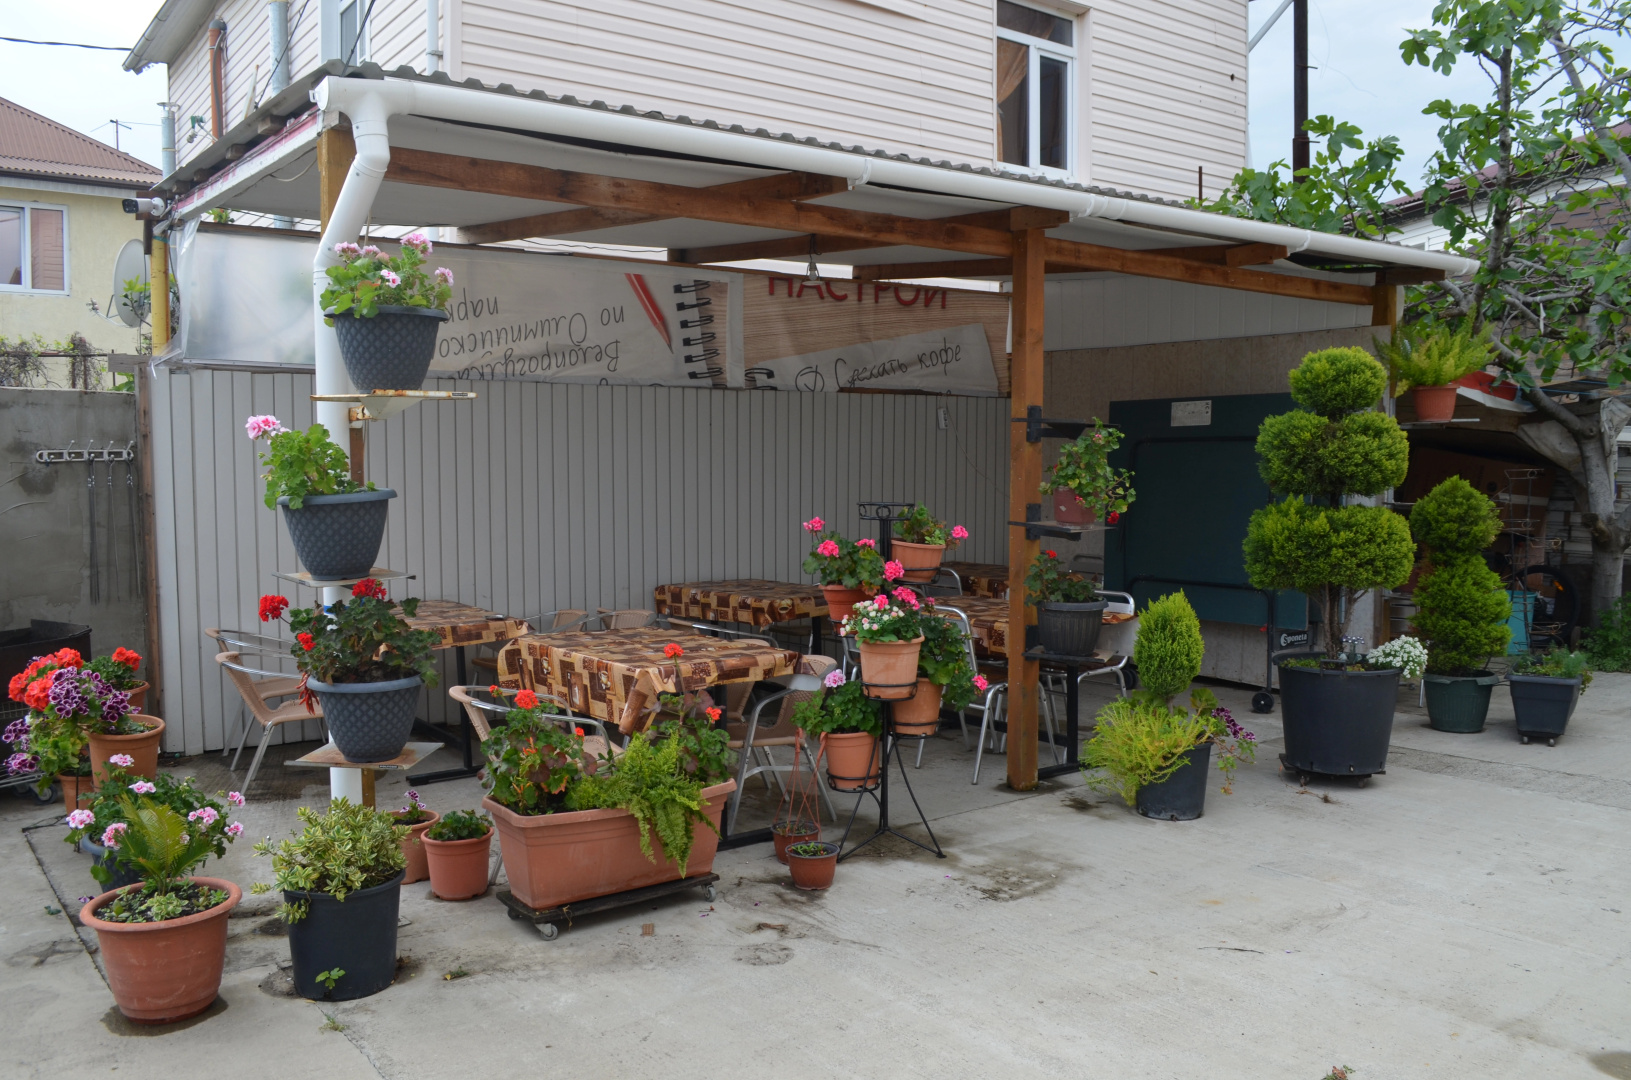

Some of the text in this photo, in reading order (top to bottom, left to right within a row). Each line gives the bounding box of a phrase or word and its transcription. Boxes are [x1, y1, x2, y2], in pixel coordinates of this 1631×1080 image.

[432, 305, 625, 360] по Олимпийско
[917, 337, 961, 376] кофе
